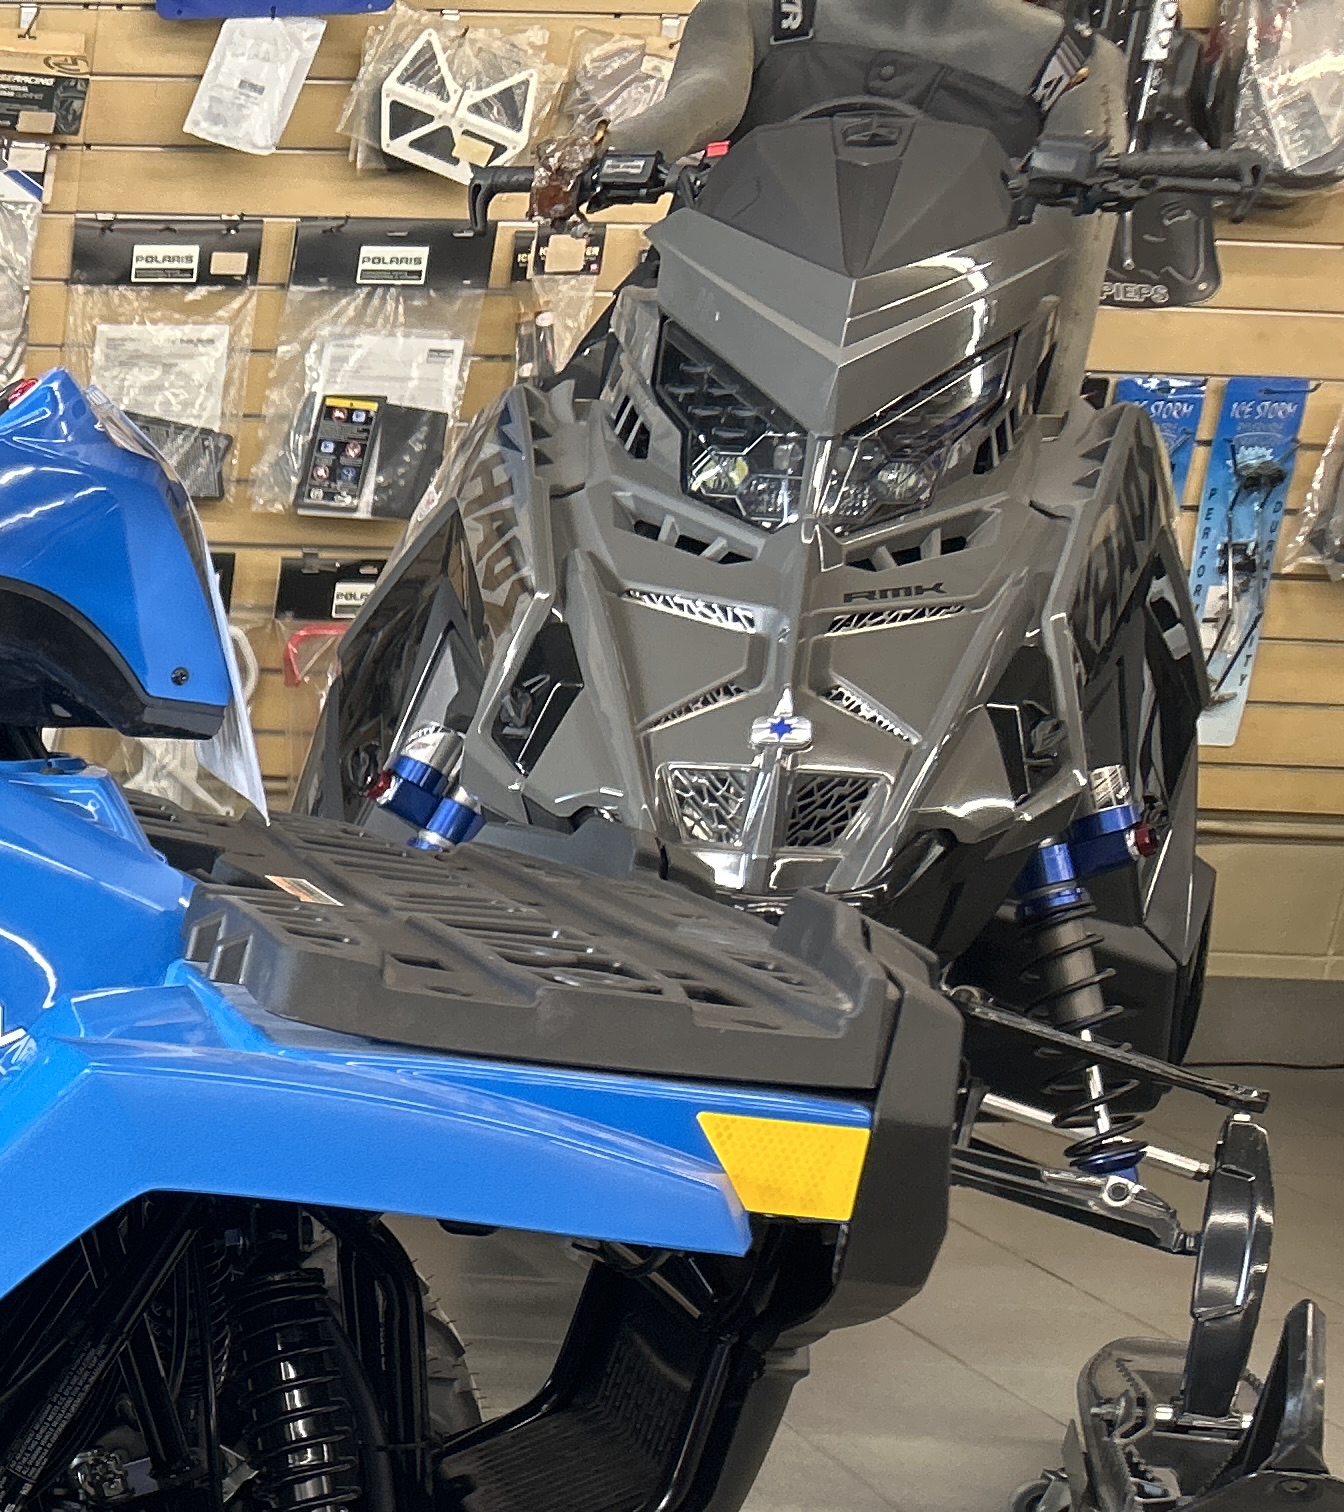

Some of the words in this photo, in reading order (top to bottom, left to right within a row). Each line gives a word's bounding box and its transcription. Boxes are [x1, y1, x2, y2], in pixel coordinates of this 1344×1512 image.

[135, 254, 194, 264] POLARIS
[362, 256, 423, 265] POLARIS
[1100, 282, 1170, 304] PIEPS
[1150, 400, 1194, 419] STORM
[1230, 401, 1255, 419] ICE
[1257, 401, 1298, 419] STORM
[336, 591, 370, 600] POLA
[844, 582, 947, 603] RMK
